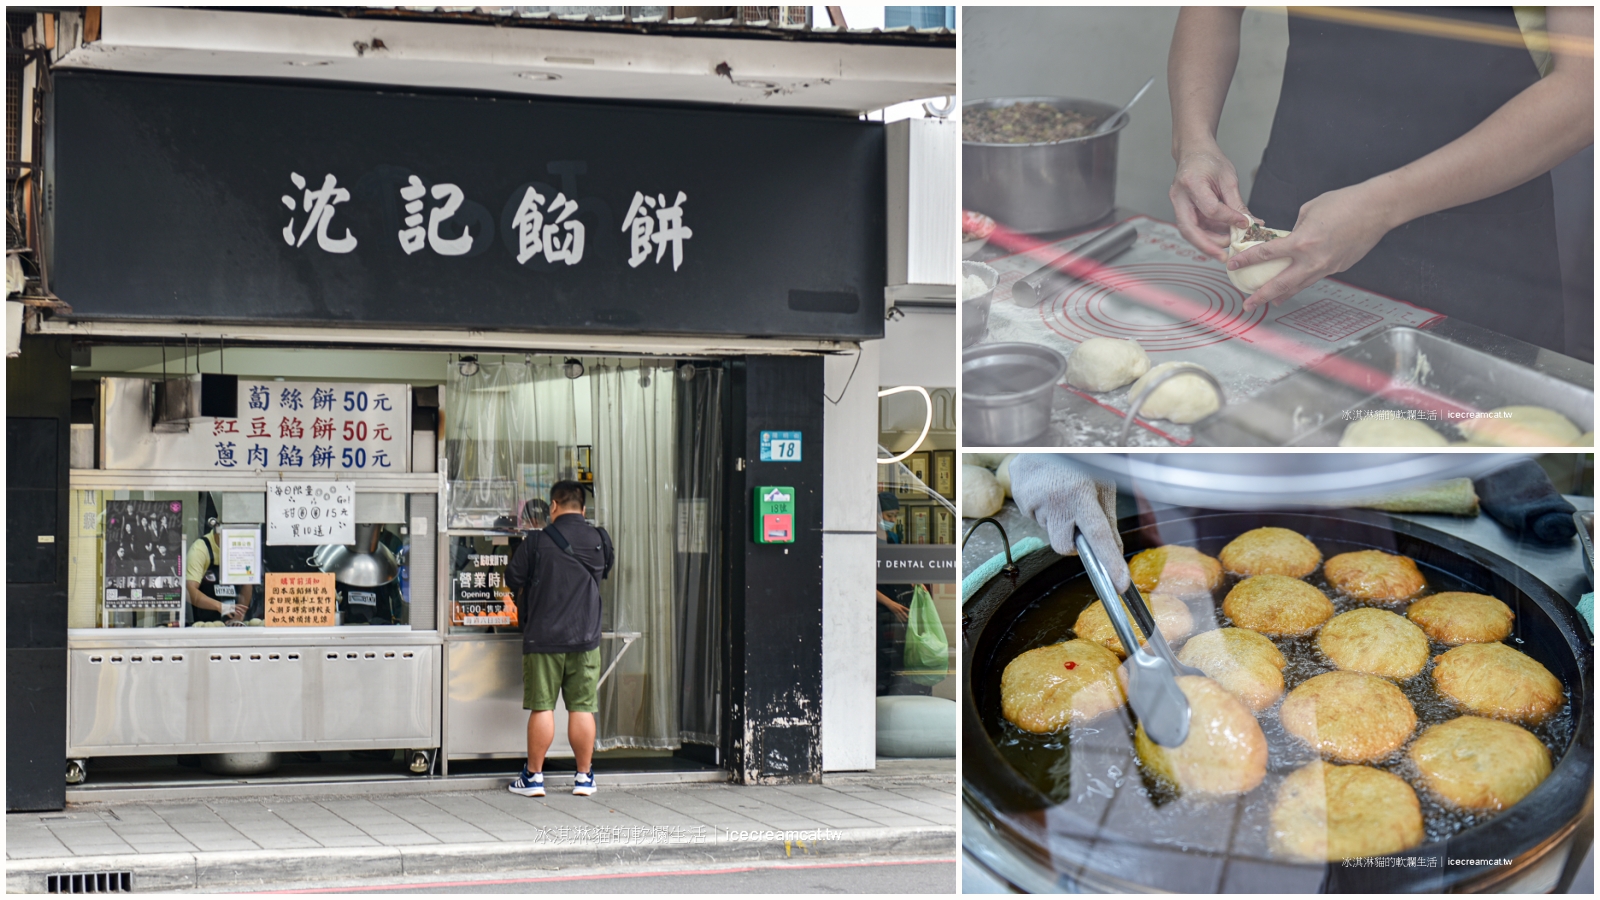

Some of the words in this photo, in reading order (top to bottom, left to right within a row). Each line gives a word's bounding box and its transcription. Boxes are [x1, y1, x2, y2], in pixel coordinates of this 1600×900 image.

[281, 171, 693, 272] 沈記餡餅
[248, 385, 393, 412] 蔔絲餅50元
[778, 442, 795, 458] 18
[274, 485, 313, 496] 每日限量
[886, 560, 924, 568] DENTAL
[459, 571, 508, 589] 營業時
[461, 590, 490, 599] Opening
